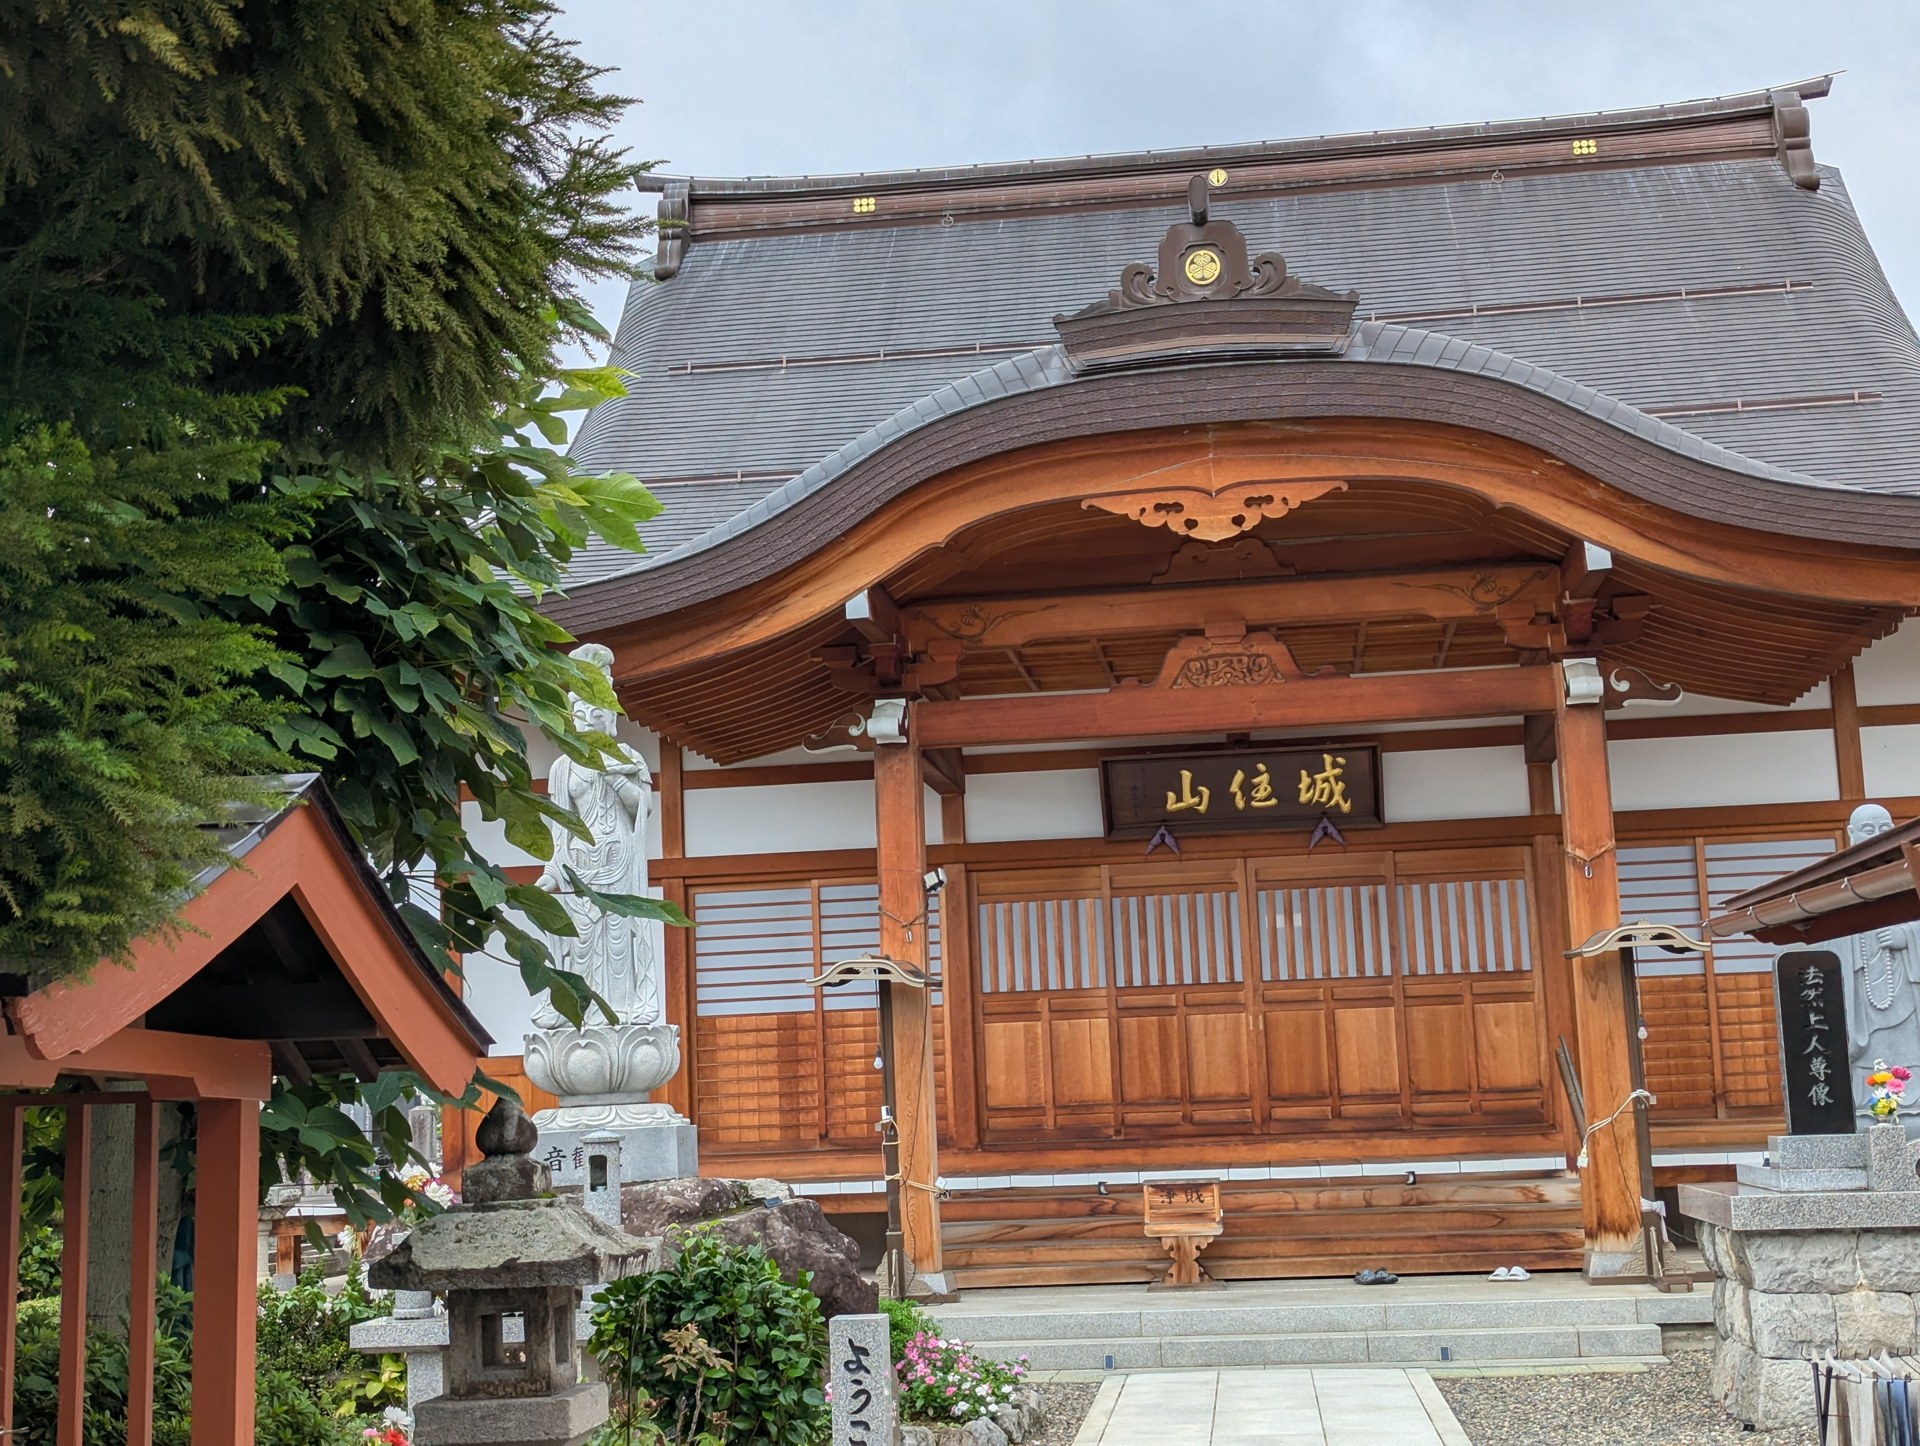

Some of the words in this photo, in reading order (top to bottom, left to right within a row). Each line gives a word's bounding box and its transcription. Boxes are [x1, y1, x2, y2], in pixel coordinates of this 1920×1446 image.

[1799, 965, 1835, 1106] 法然上人尊像
